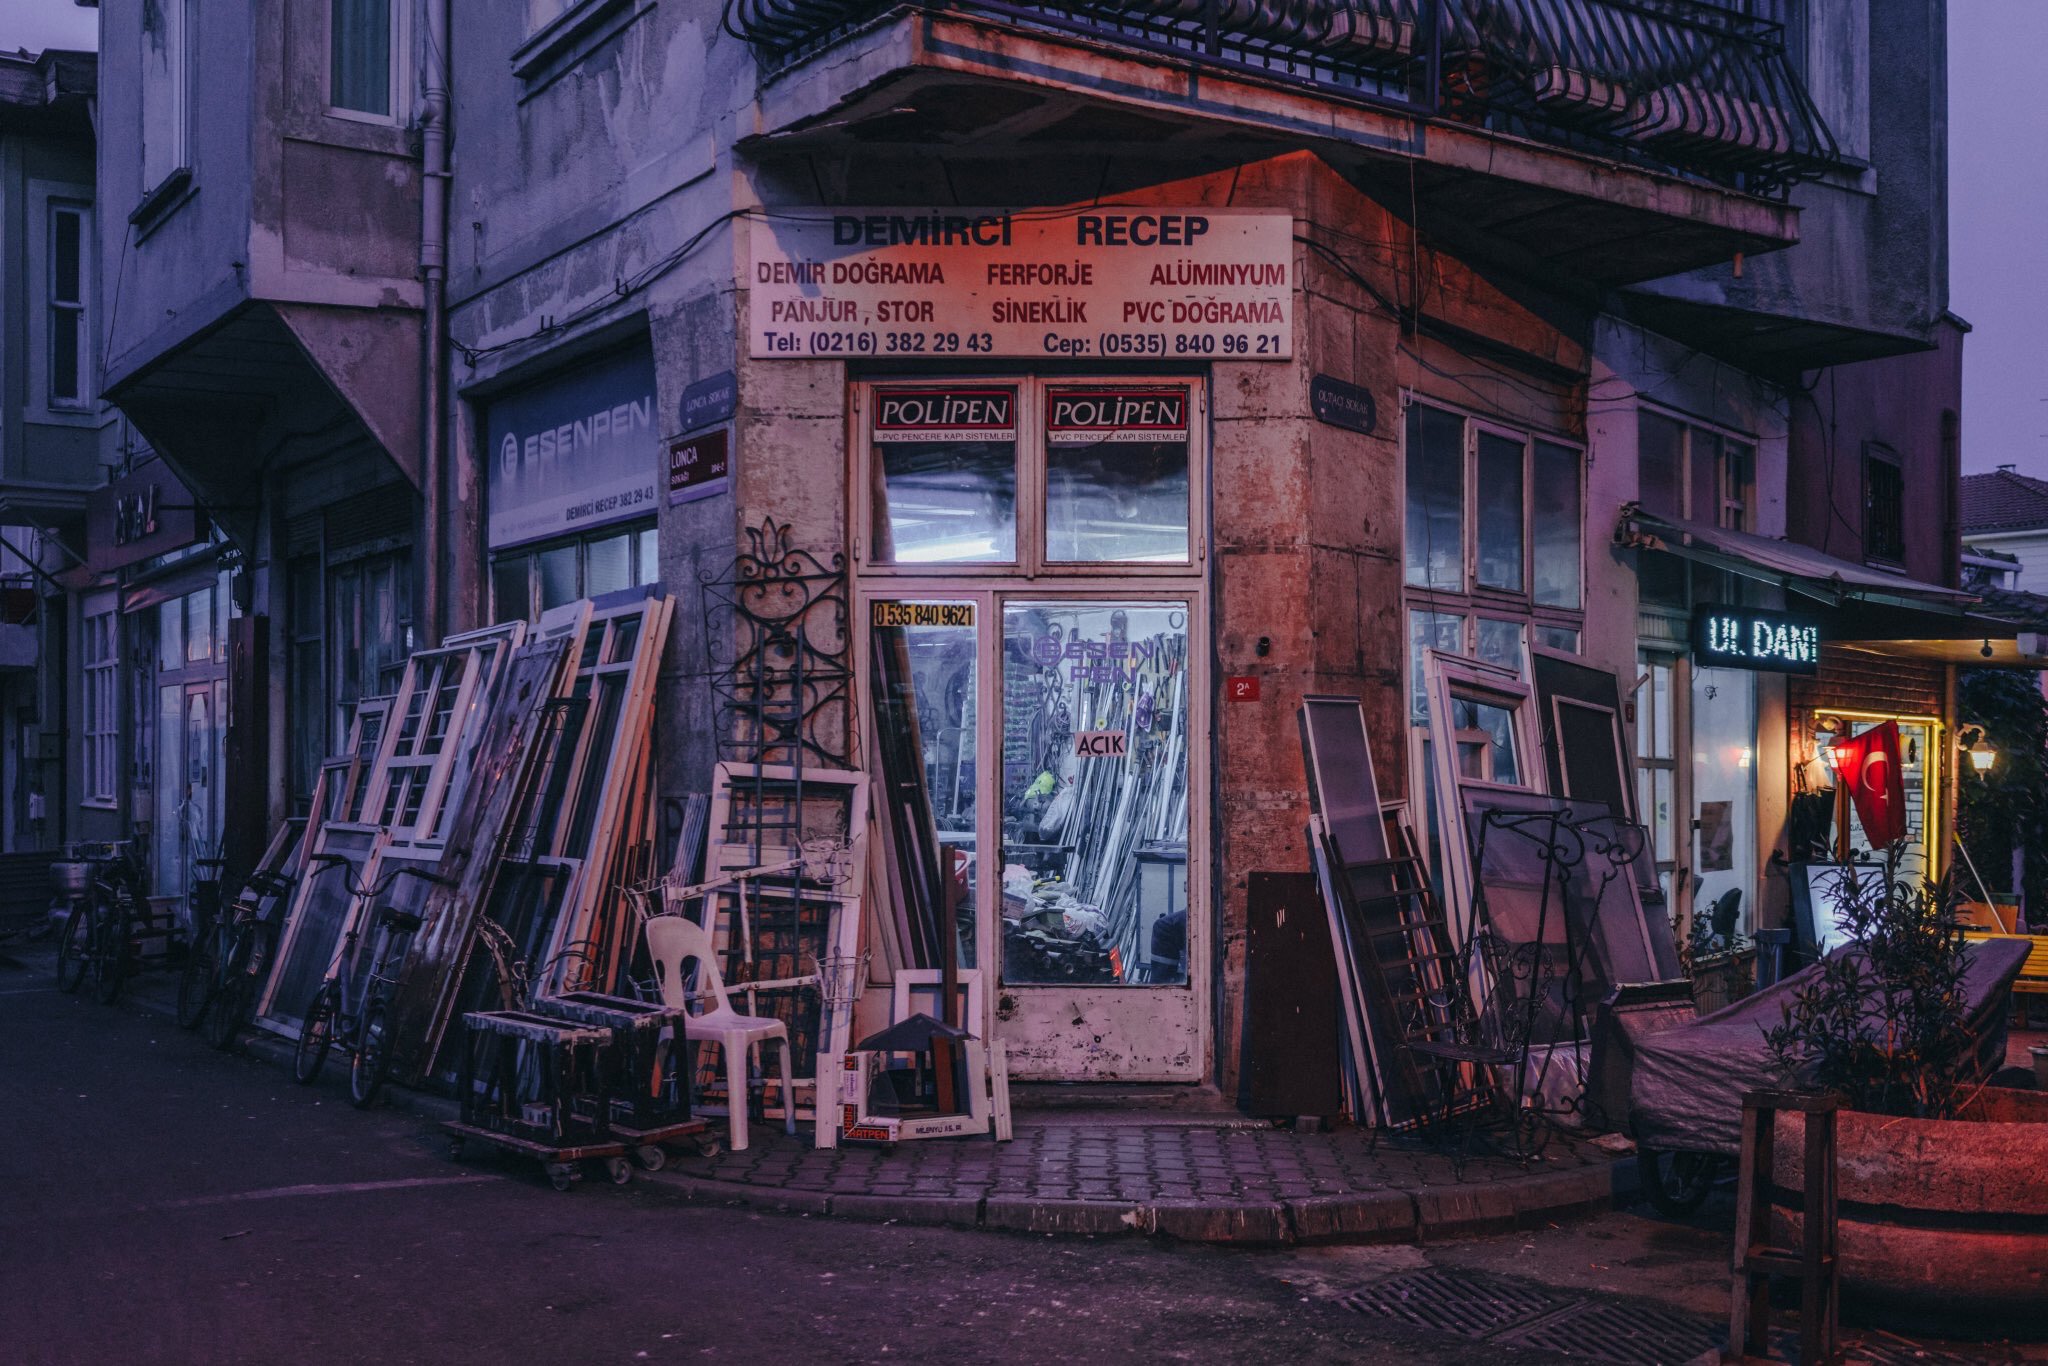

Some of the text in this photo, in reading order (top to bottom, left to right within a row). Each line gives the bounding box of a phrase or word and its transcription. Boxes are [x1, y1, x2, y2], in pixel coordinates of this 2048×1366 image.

[833, 209, 1209, 246] DEMİRCİ RECEP
[758, 258, 826, 284] DEMİR
[833, 257, 945, 284] DOĞRAMA
[987, 259, 1093, 285] FERFORJE
[877, 300, 934, 322] STOR
[992, 297, 1087, 323] SİNEKLİK
[1123, 302, 1165, 323] PVC
[1172, 296, 1284, 324] DOĞRAMA
[763, 332, 1281, 356] Tel: (0216) 382 29 43 Cep: (0535) 840 96 21
[881, 394, 1008, 425] POLİPEN
[1053, 395, 1180, 426] POLİPEN
[524, 396, 651, 465] ESENPEN
[902, 432, 941, 441] PENCERE
[944, 432, 963, 440] KAPI
[1074, 433, 1114, 441] PENCERE
[1116, 432, 1136, 441] KAPI
[671, 446, 698, 469] LONCA
[595, 495, 618, 514] RECEP
[619, 491, 632, 507] 382
[633, 489, 643, 504] 29
[644, 486, 654, 500] 43
[876, 604, 972, 626] 0 535 840 9621
[1066, 642, 1154, 659] ESEN
[1070, 666, 1137, 683] PEN
[1077, 735, 1124, 756] AÇIK
